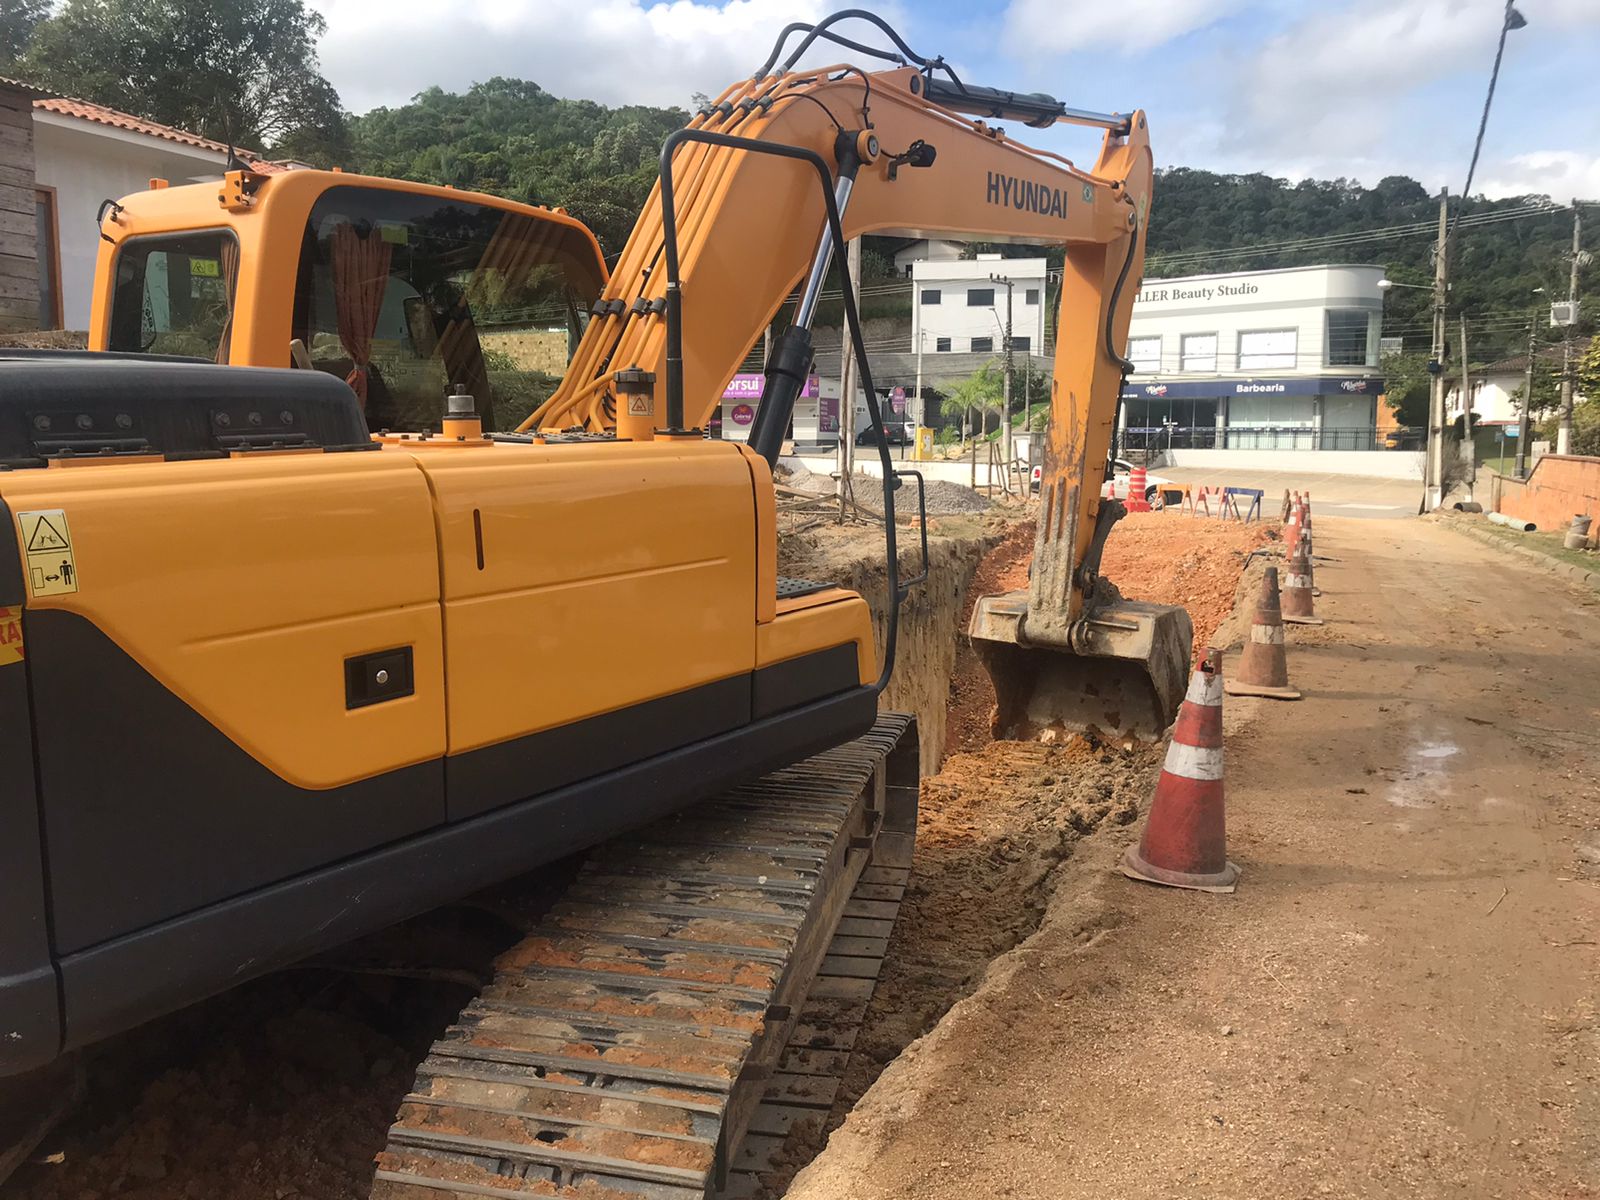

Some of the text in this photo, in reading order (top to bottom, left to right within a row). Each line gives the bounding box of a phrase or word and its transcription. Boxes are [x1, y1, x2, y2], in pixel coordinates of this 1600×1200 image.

[986, 171, 1067, 219] HYUNDAI
[1172, 288, 1214, 301] Beauty
[1217, 282, 1259, 297] Studio
[1236, 383, 1285, 393] Barbearia
